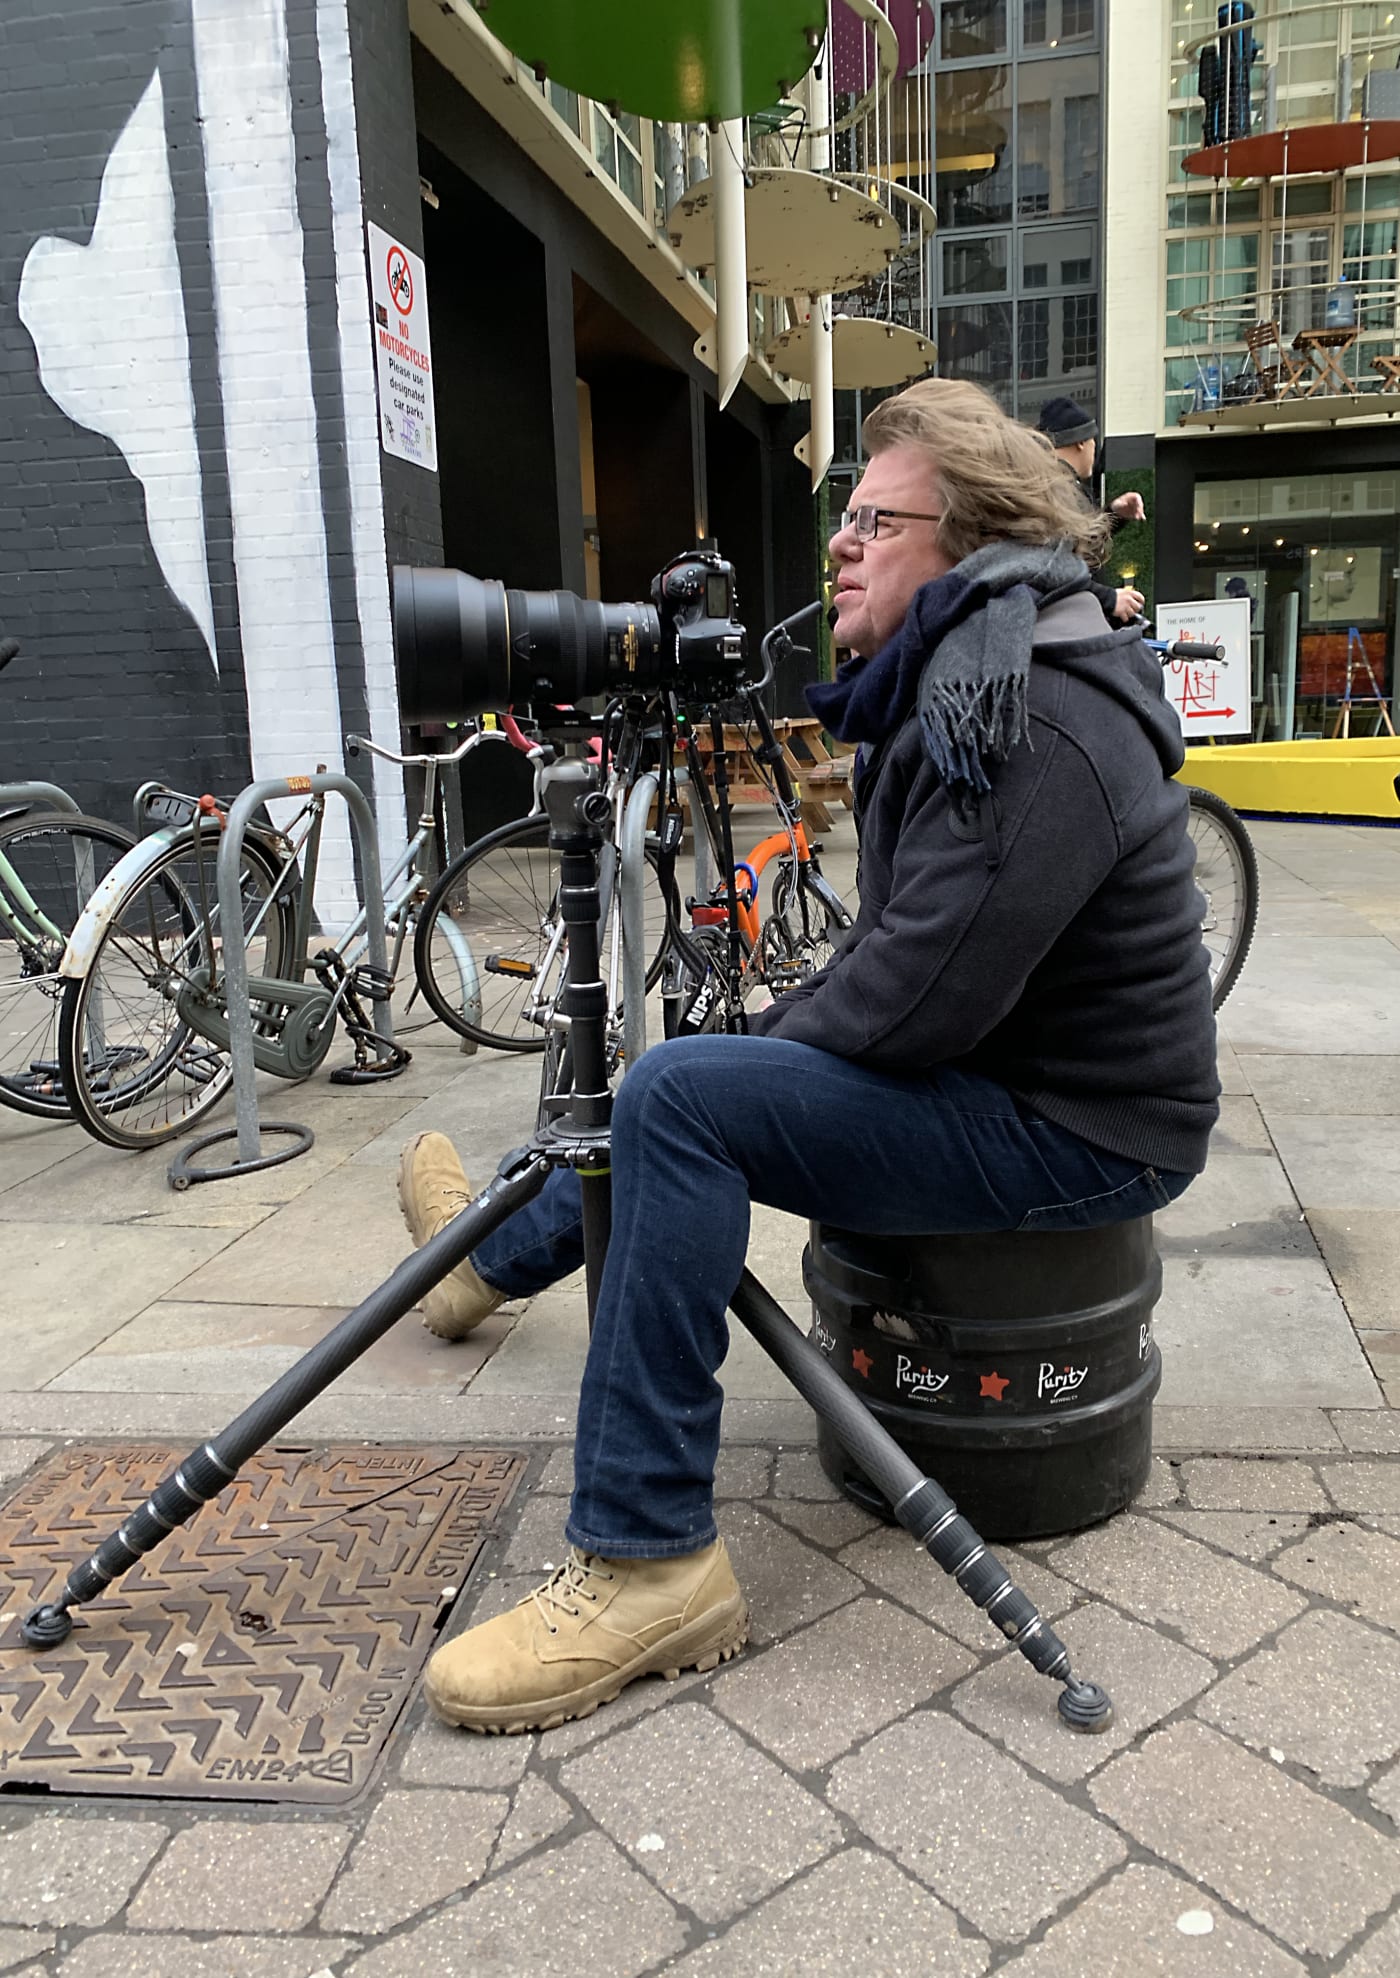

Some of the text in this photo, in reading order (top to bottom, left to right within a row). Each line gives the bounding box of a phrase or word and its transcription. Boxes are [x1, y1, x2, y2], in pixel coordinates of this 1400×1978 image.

[398, 319, 409, 340] NO
[378, 328, 430, 373] MOTORCYCLES
[388, 356, 424, 387] Please use
[389, 375, 426, 404] designated
[393, 397, 425, 421] car parks
[1179, 617, 1196, 625] HOME
[1174, 665, 1221, 714] ART
[685, 984, 714, 1027] NPS
[895, 1354, 950, 1394] Purity
[1037, 1362, 1089, 1399] Purity
[424, 1486, 501, 1578] STANTON
[341, 1666, 407, 1745] D400 N
